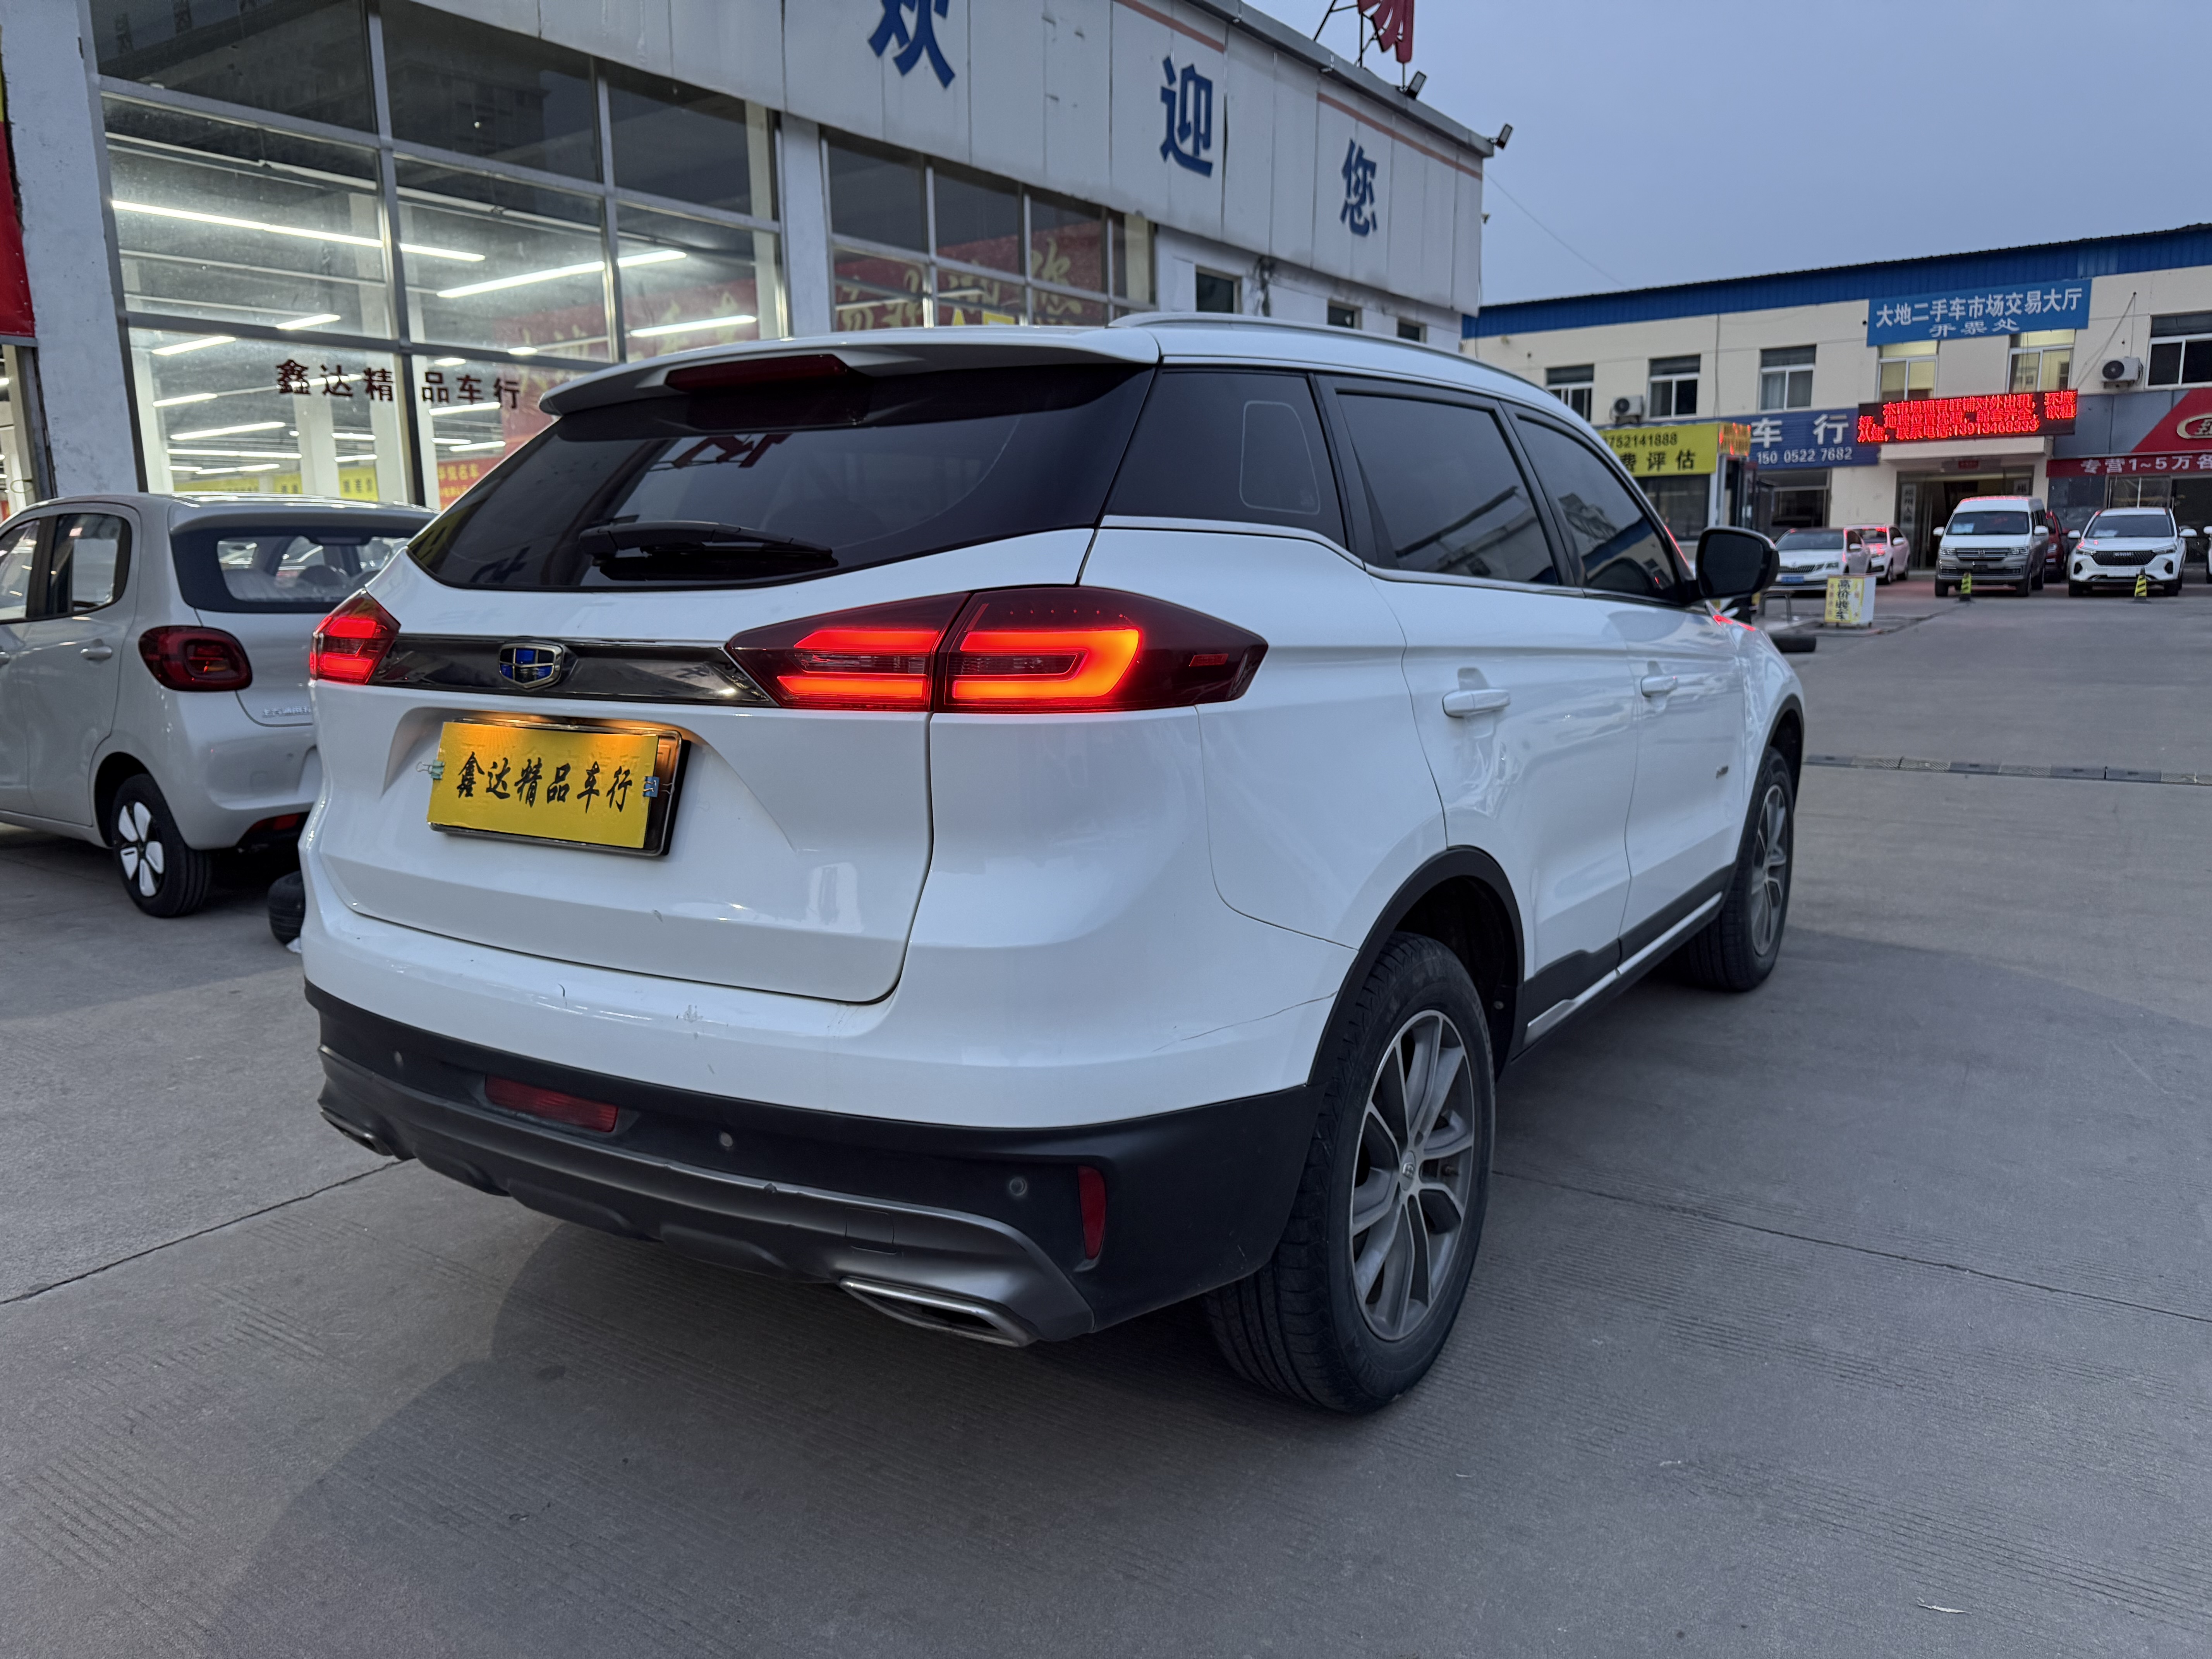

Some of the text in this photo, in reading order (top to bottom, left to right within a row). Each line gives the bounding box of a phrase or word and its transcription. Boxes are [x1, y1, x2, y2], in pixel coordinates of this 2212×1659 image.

[1876, 288, 2082, 328] 大地二手车市场交易大厅
[1929, 318, 2020, 337] 开票处
[276, 359, 520, 409] 鑫达精品车行
[1604, 432, 1678, 448] 752141888
[1750, 413, 1849, 448] 车行
[1757, 446, 1853, 465] 150 0522 7682
[456, 751, 633, 813] 鑫达精品车行
